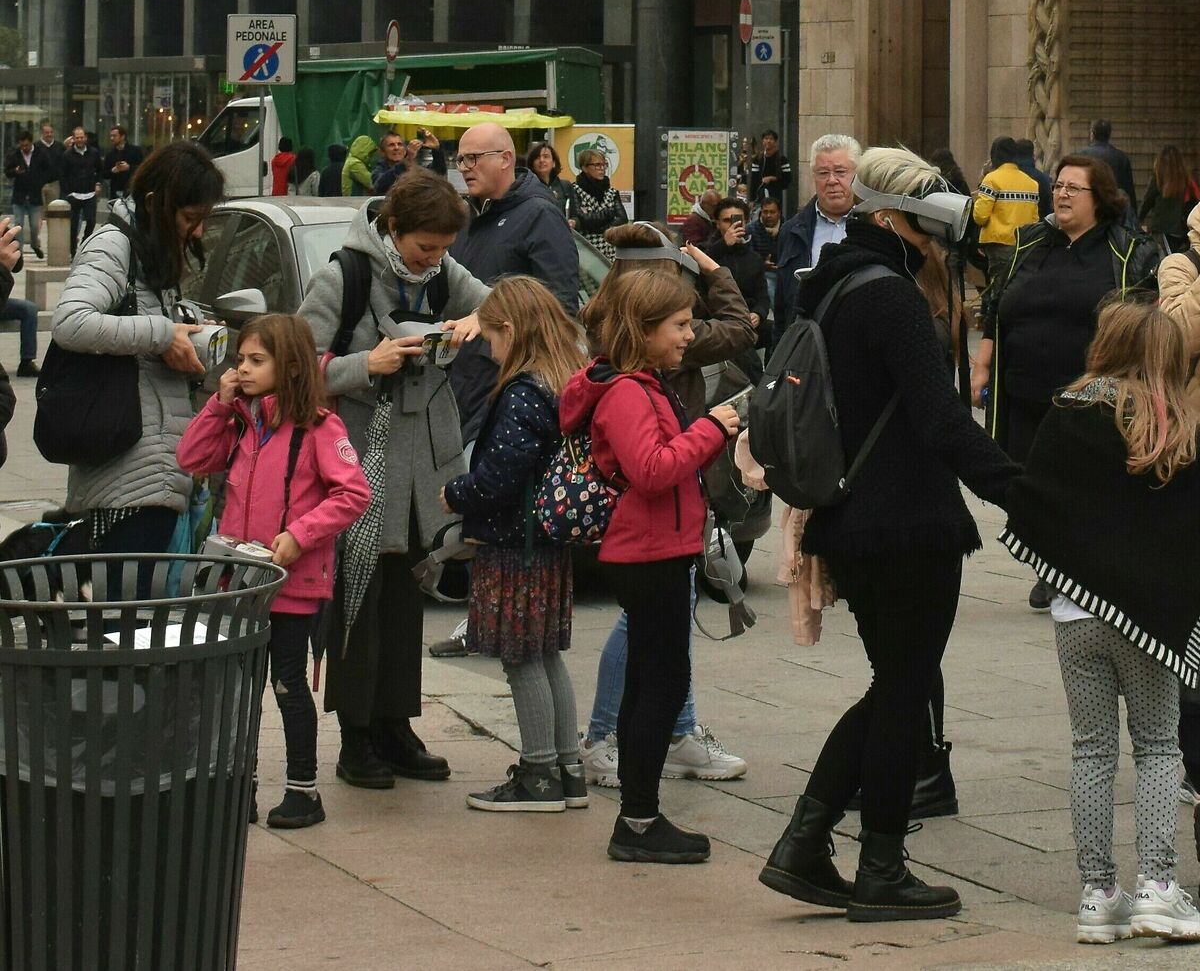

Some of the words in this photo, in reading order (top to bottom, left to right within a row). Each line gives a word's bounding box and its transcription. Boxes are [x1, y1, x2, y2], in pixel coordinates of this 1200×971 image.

[248, 19, 275, 30] AREA
[235, 31, 287, 41] PEDONALE
[669, 142, 727, 153] MILANO
[669, 154, 728, 166] ESTATE
[1080, 903, 1097, 912] FILA
